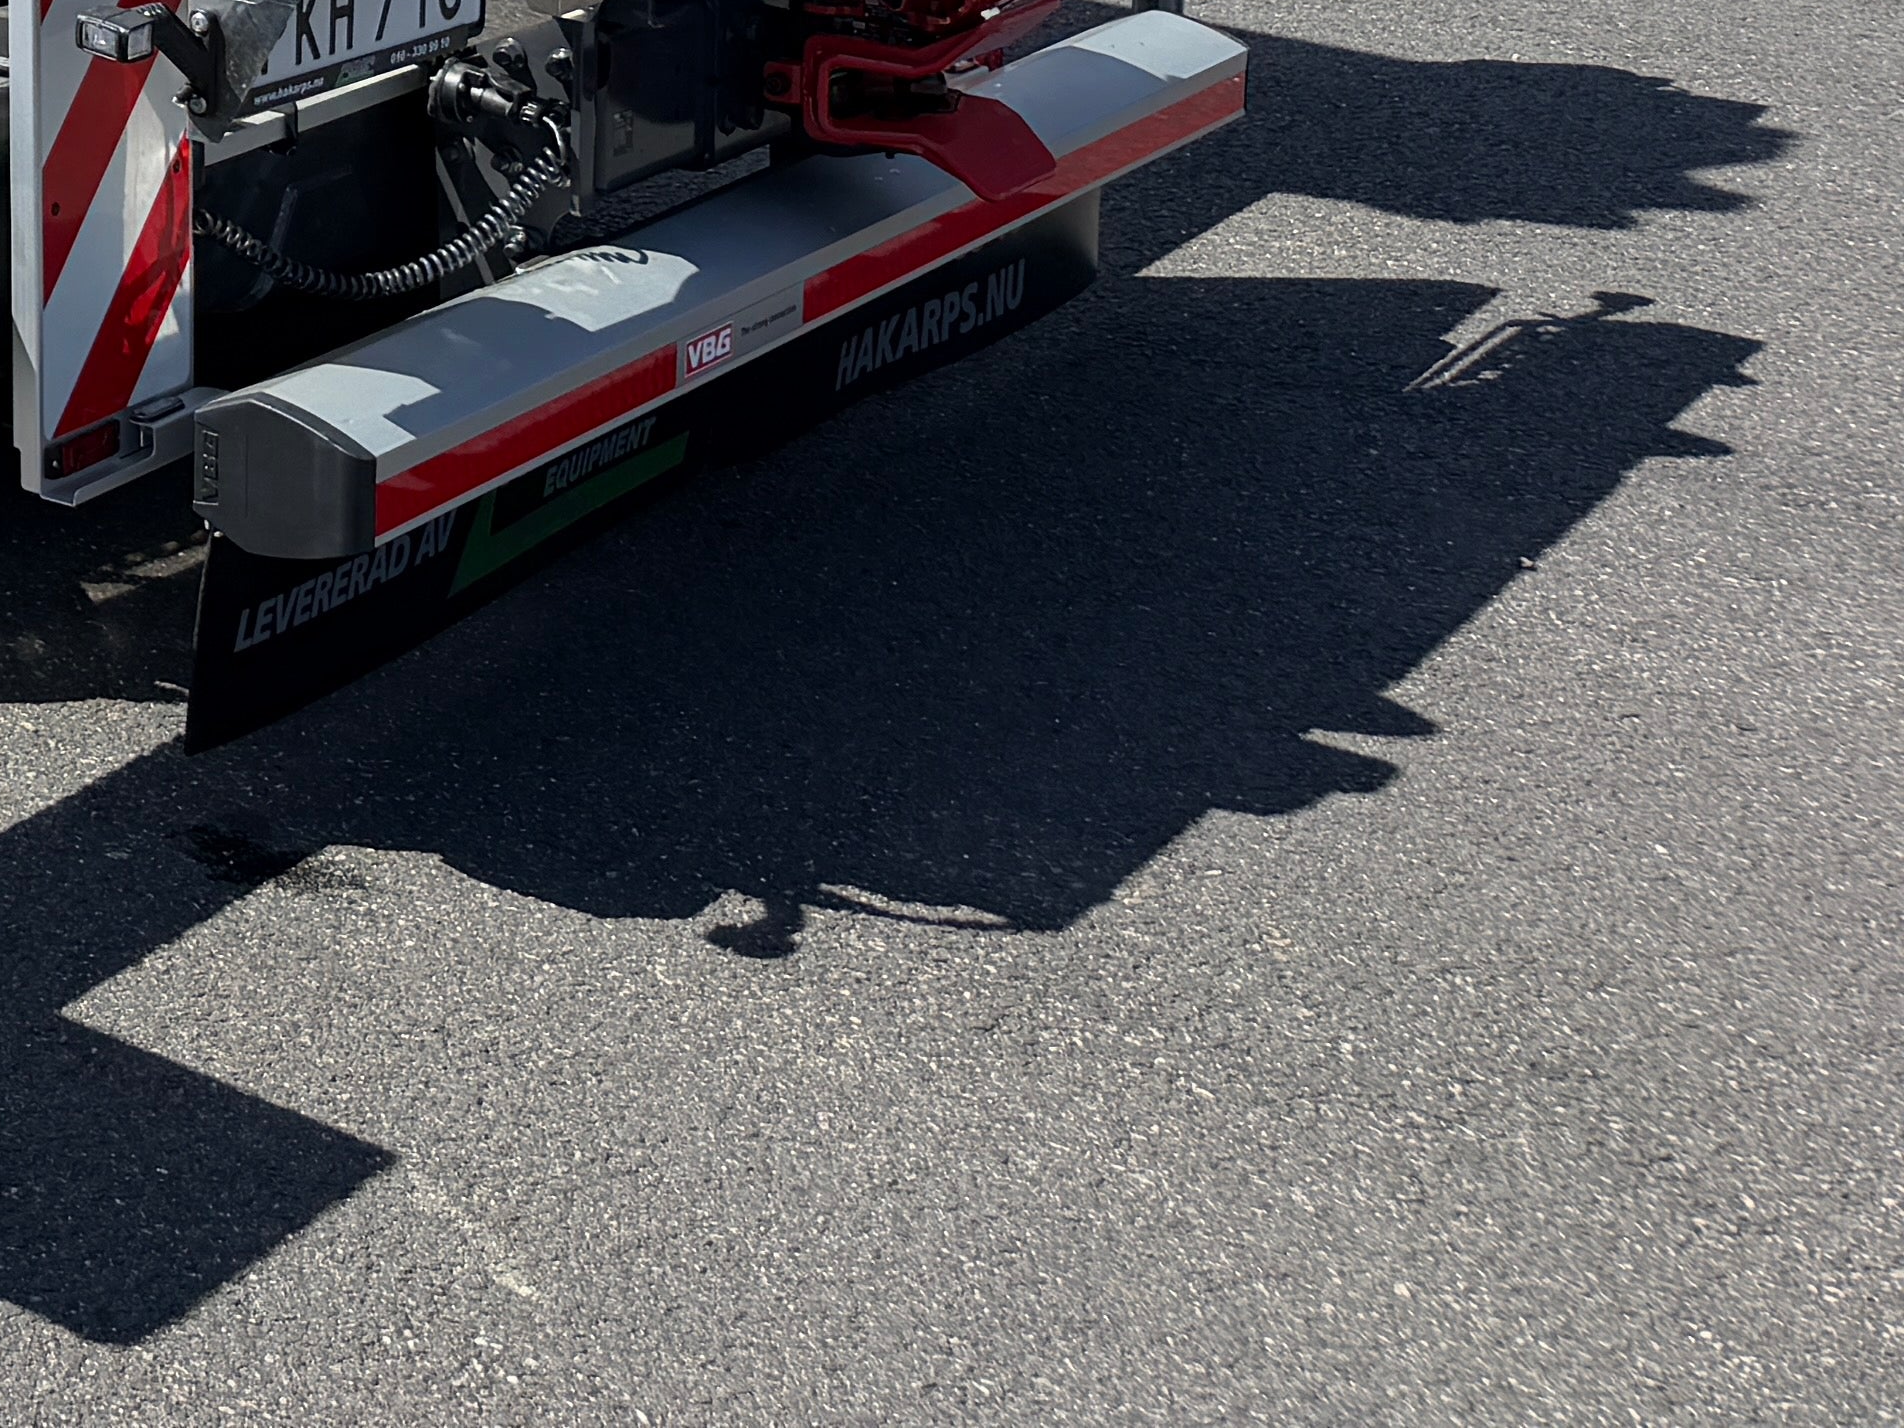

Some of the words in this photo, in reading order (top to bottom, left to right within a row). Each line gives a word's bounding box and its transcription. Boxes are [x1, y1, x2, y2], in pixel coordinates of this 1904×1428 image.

[688, 328, 732, 369] VBG
[835, 258, 1026, 392] HAKARPS.NU
[544, 416, 657, 497] EQUIPMENT
[233, 534, 411, 653] LEVERERAD
[414, 508, 457, 566] AV
